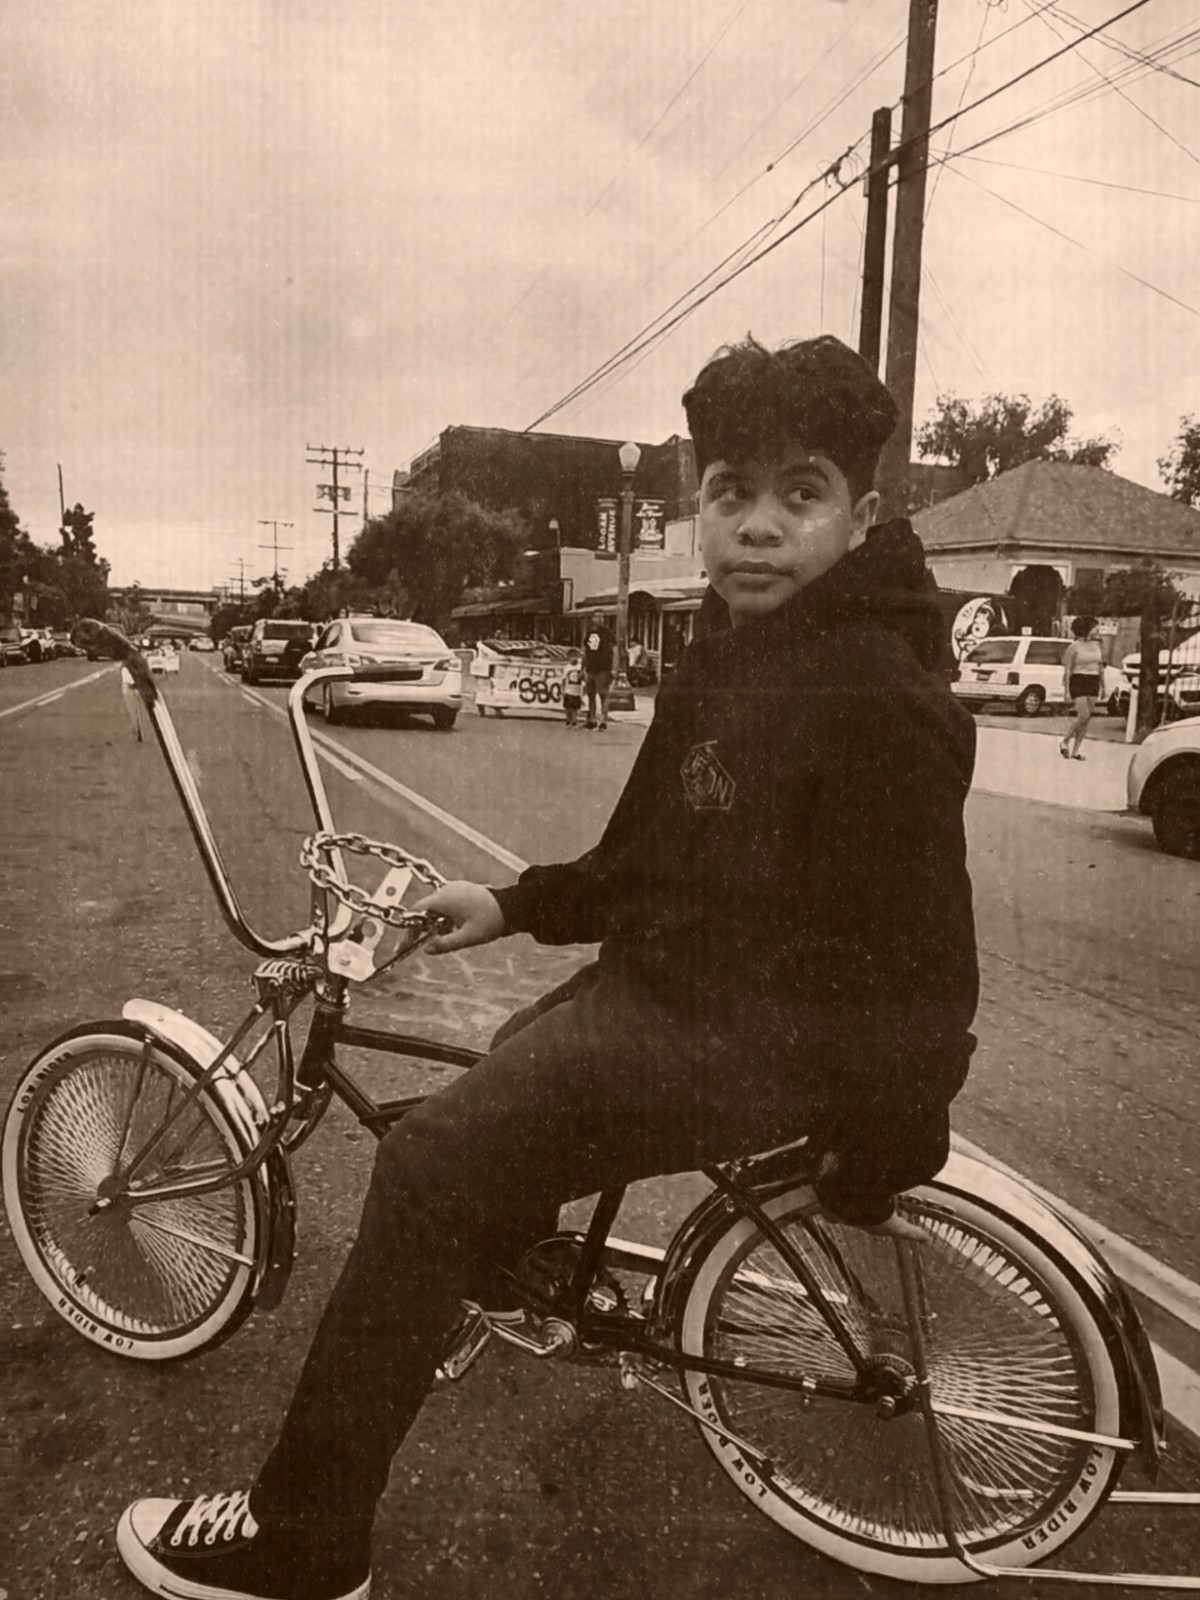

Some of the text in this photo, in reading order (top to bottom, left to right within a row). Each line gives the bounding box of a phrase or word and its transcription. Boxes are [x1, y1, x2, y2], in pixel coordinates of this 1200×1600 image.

[607, 509, 616, 552] AVENUE
[58, 1297, 134, 1350] LOW RIDER
[731, 1458, 768, 1498] LOW
[1021, 1448, 1103, 1550] LOW RIDER
